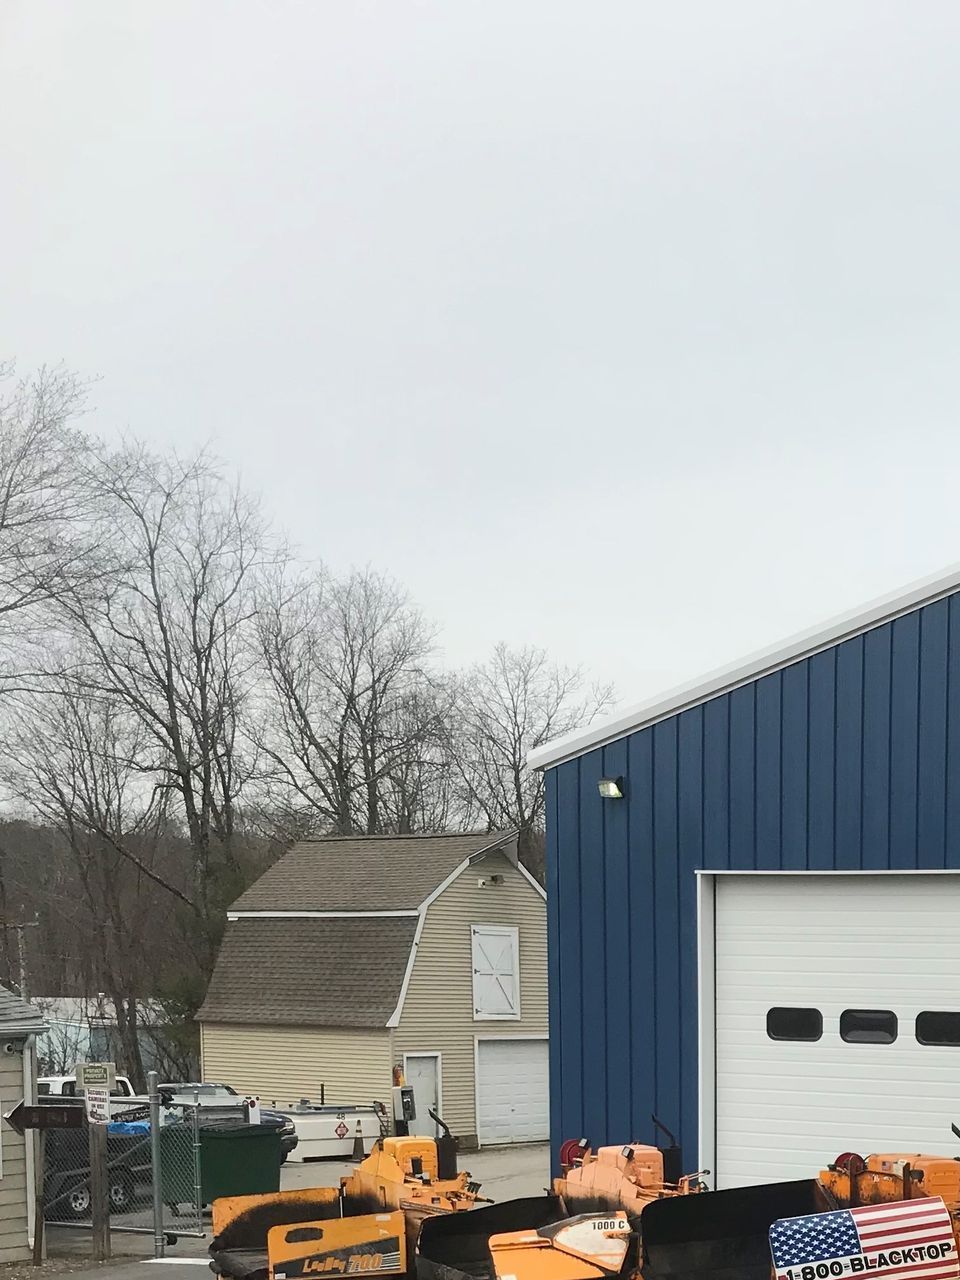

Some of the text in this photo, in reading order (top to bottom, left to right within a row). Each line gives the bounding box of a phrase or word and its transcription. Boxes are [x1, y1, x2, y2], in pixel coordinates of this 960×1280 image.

[336, 1112, 346, 1120] 48
[592, 1220, 625, 1230] 1000 C
[349, 1253, 383, 1273] 700
